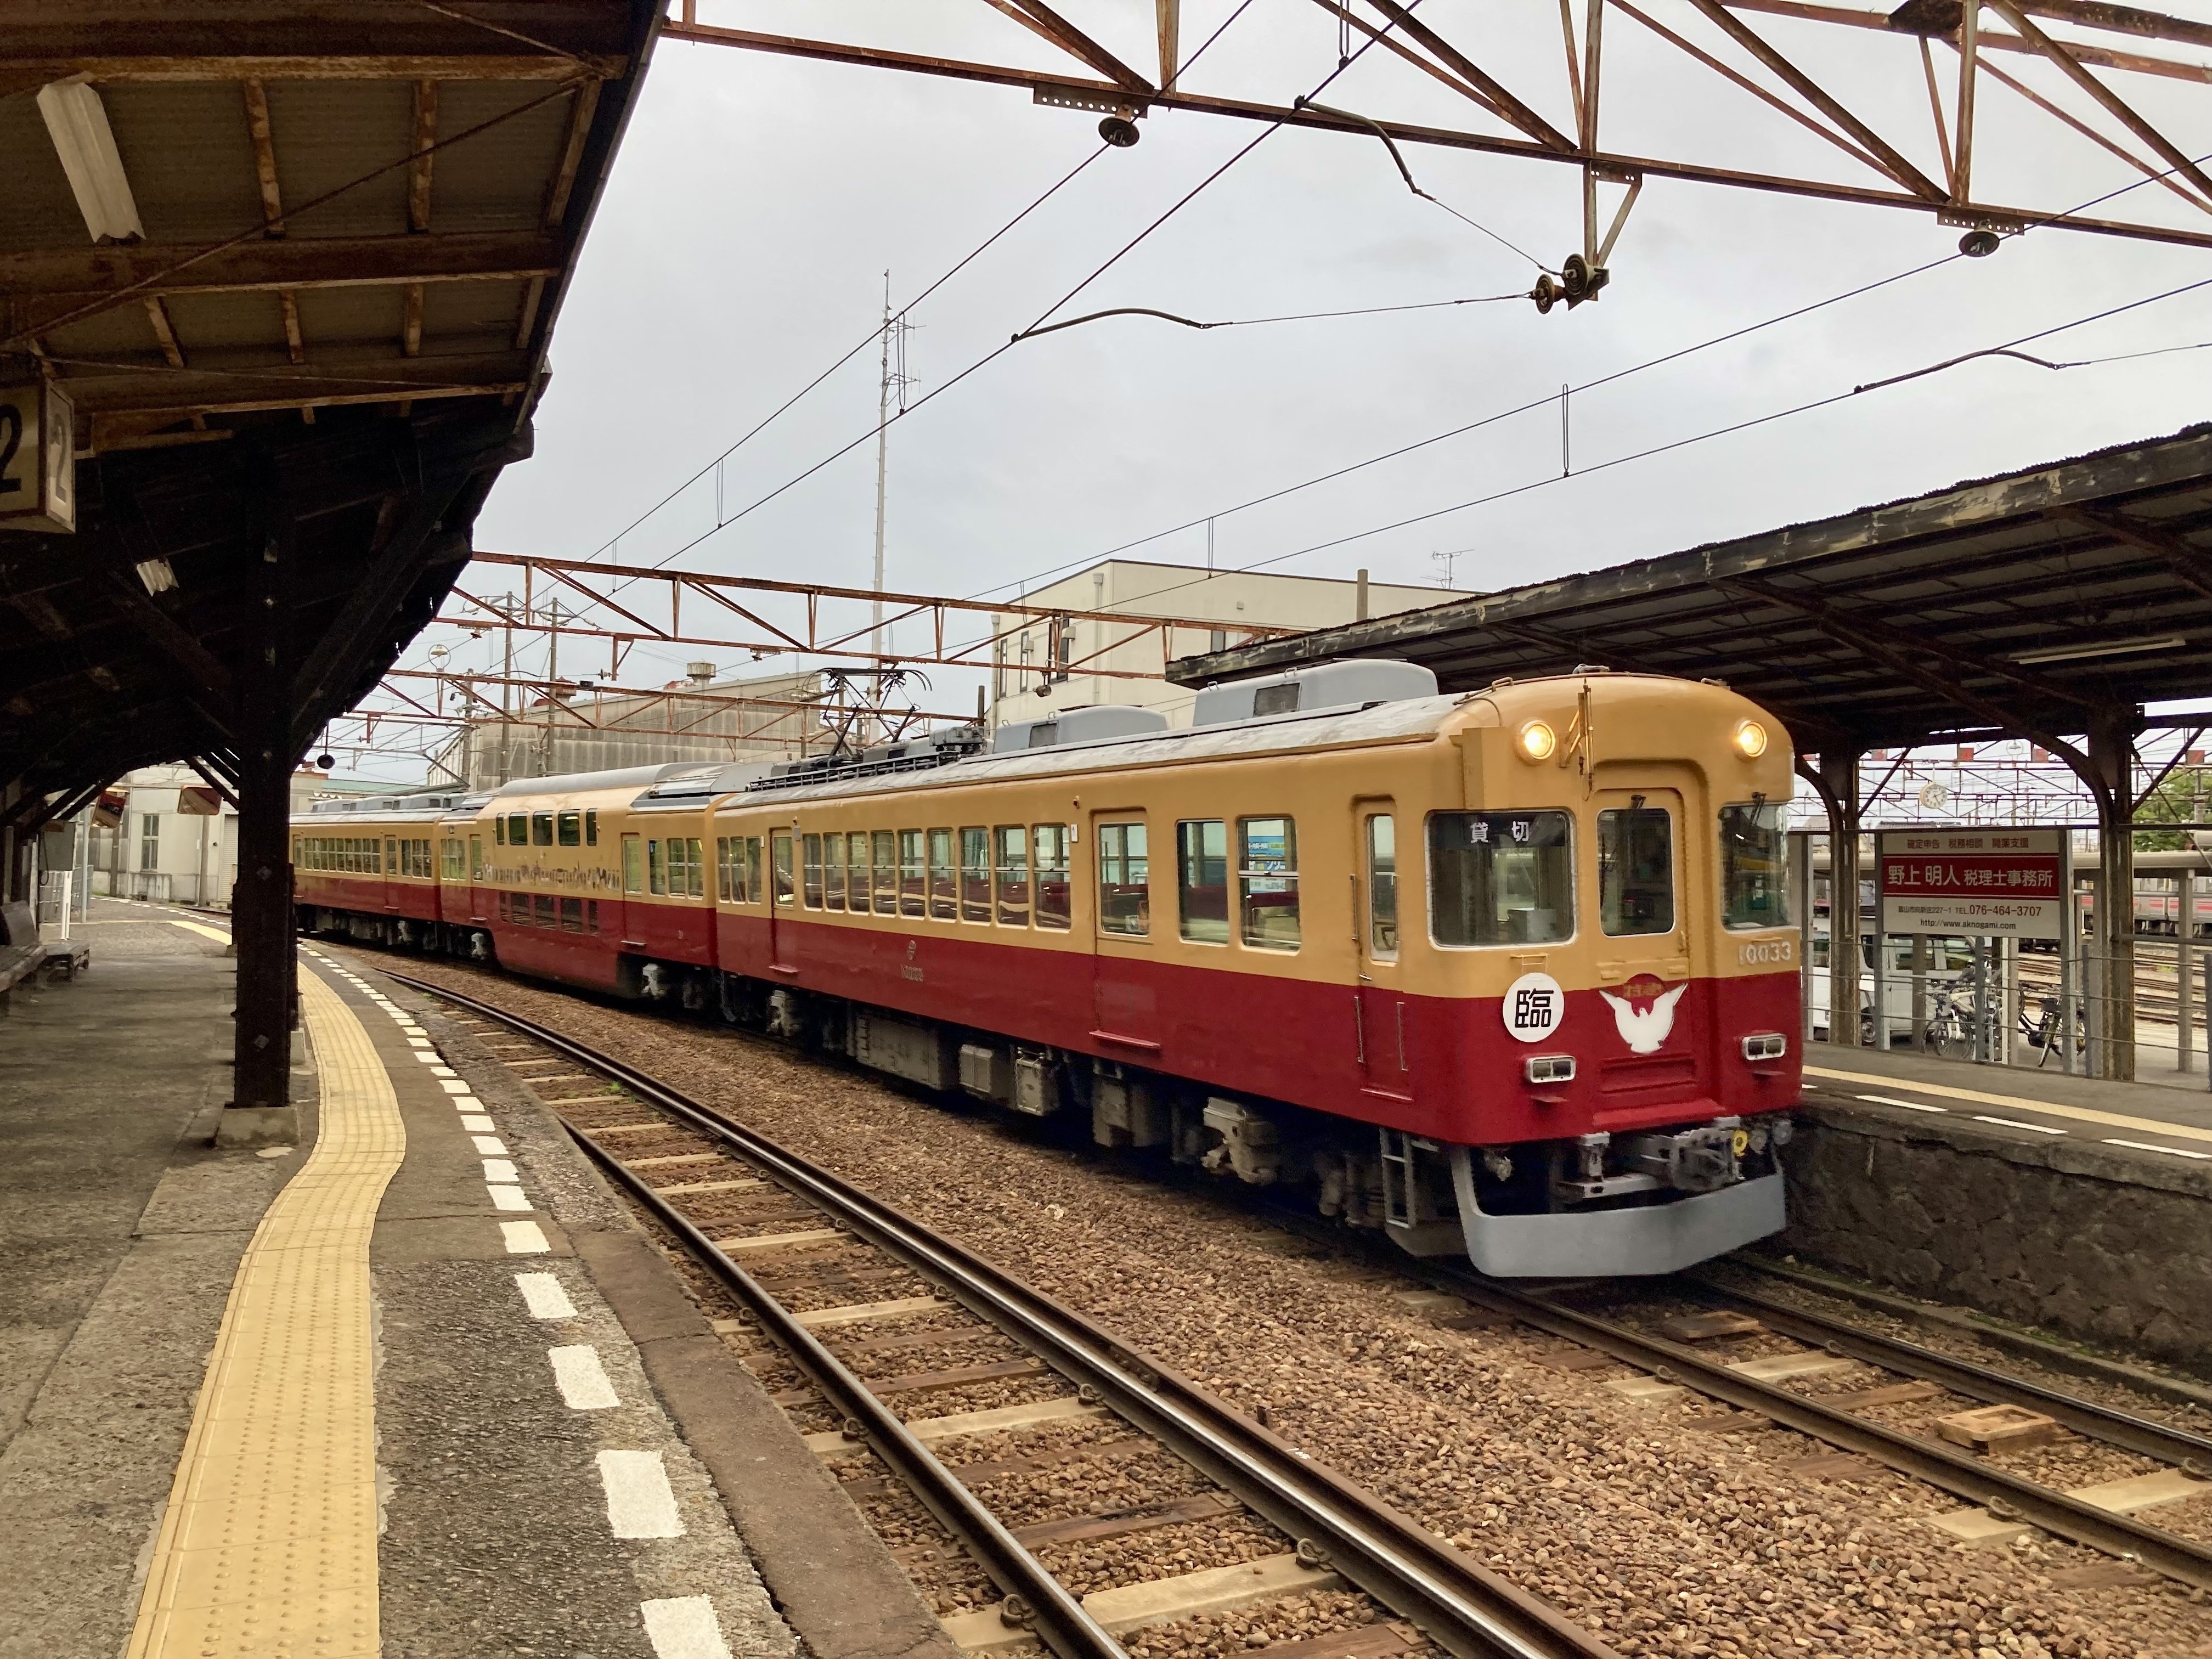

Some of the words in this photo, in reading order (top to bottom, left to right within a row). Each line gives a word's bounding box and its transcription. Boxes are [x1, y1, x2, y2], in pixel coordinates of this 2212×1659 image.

[0, 404, 22, 493] 2
[1907, 839, 1940, 849] 確定申告
[1888, 865, 1921, 885] 野上
[1925, 865, 1960, 886] 明人
[1963, 869, 2053, 887] 税理士事務所
[1920, 918, 2016, 929] http://www.aknogami.com
[1738, 941, 1791, 966] 10033
[1515, 988, 1554, 1028] 臨
